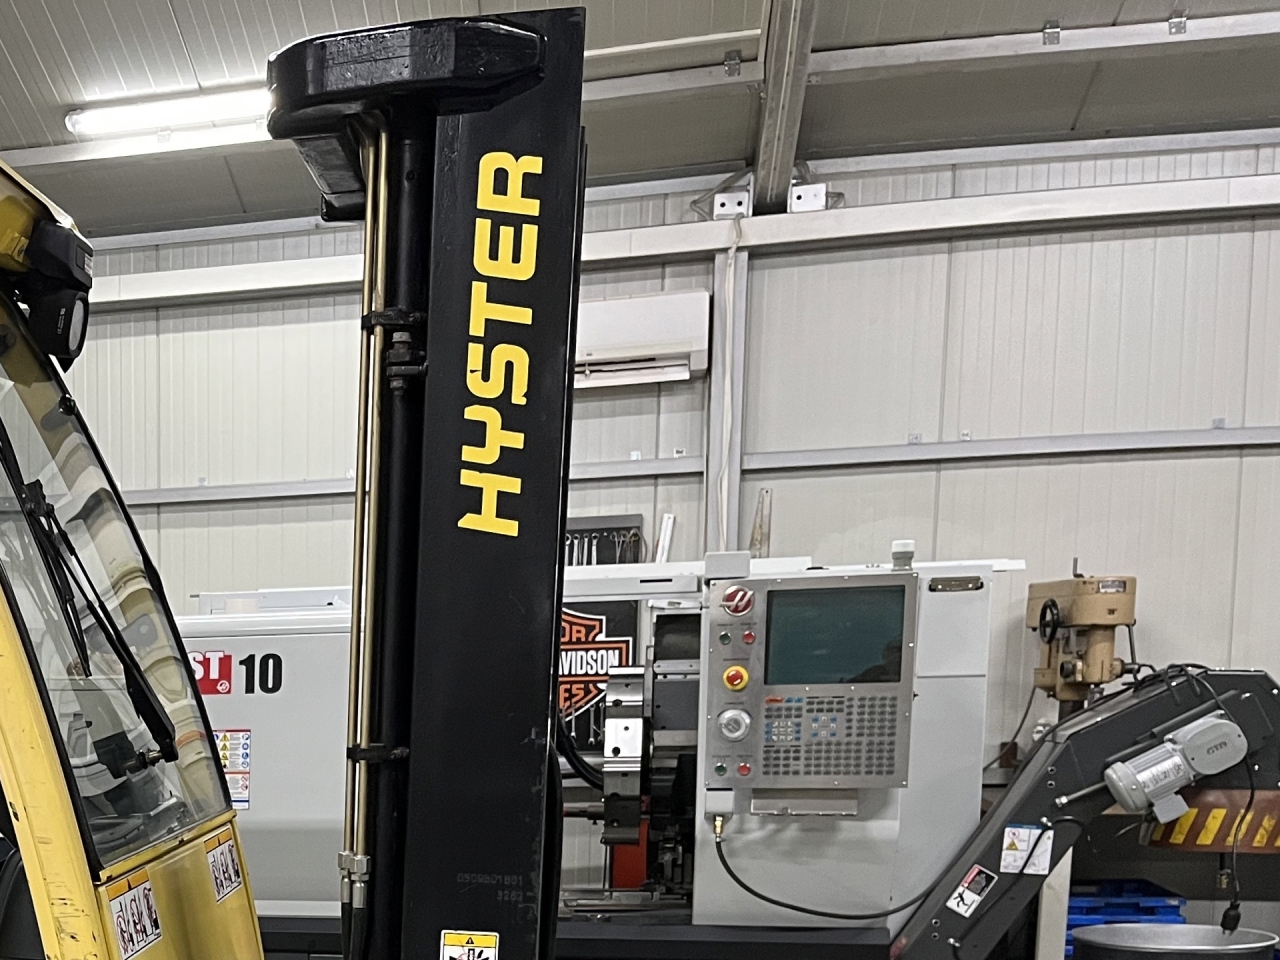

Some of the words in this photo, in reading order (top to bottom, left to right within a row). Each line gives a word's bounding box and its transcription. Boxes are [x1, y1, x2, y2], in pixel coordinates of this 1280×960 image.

[457, 151, 543, 537] HYSTER
[187, 650, 224, 681] ST
[239, 653, 283, 695] 10
